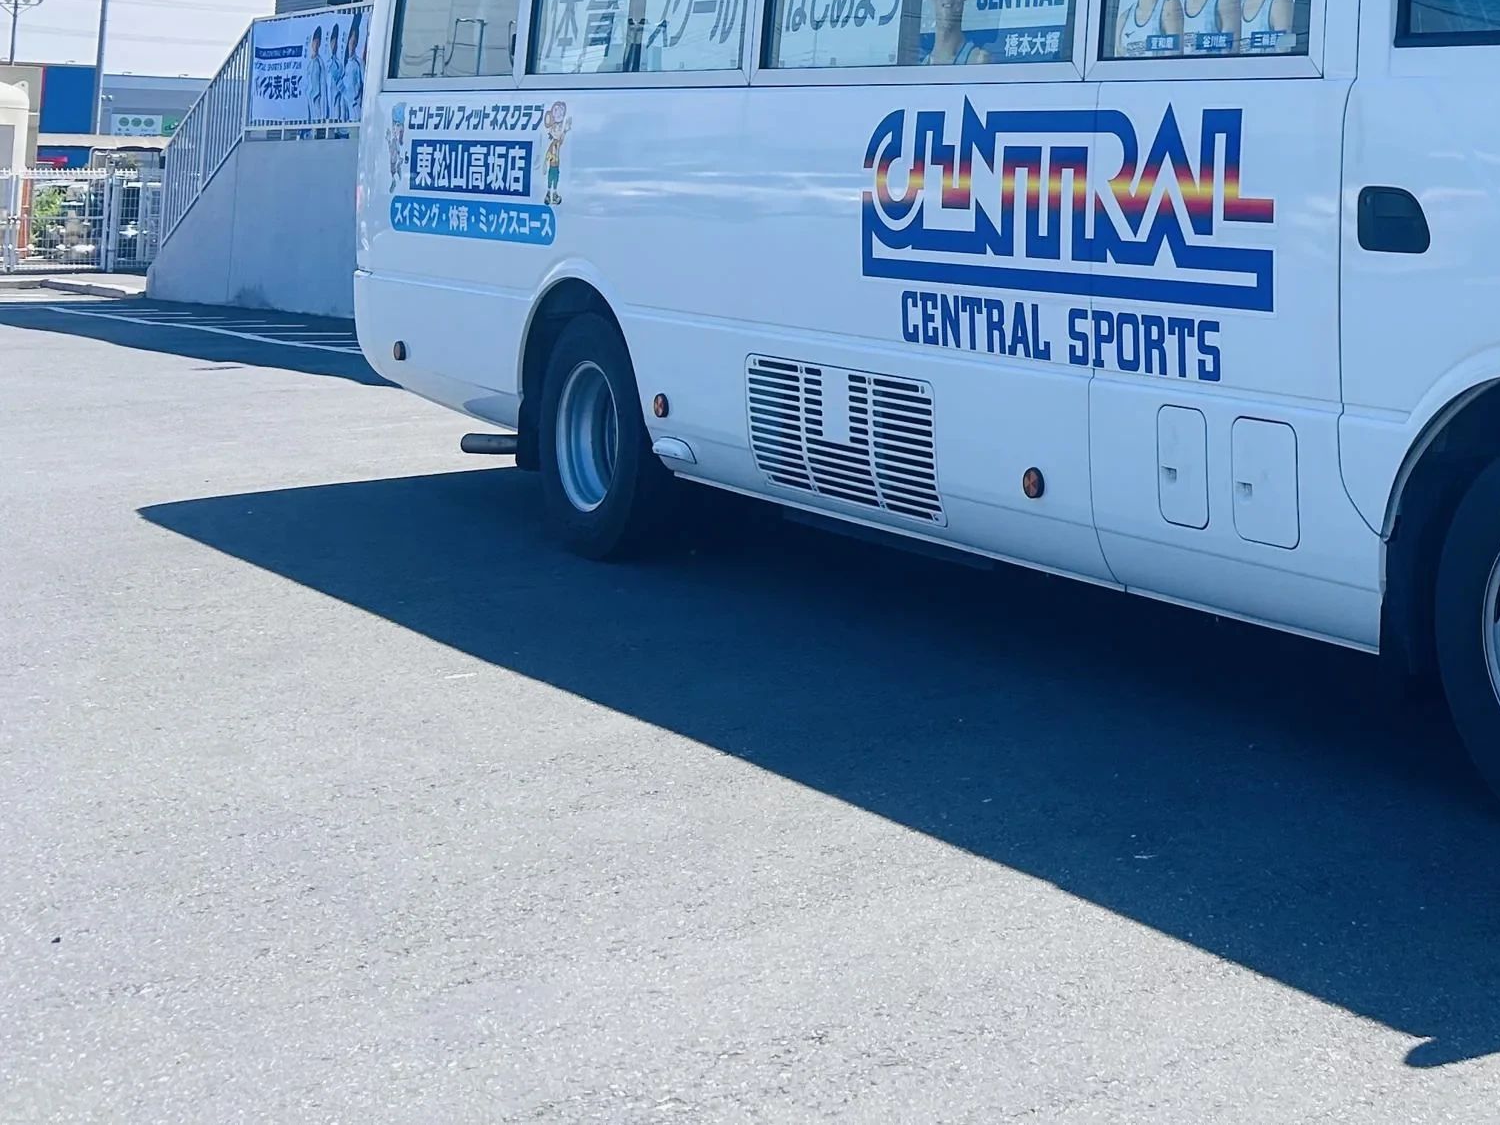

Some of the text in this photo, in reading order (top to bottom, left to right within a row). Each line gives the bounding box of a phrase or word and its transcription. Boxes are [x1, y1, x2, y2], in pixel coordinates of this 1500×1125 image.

[415, 143, 527, 193] 東松山高坂店
[862, 94, 1275, 313] CENTRAL
[901, 290, 1222, 383] CENTRAL SPORTS
